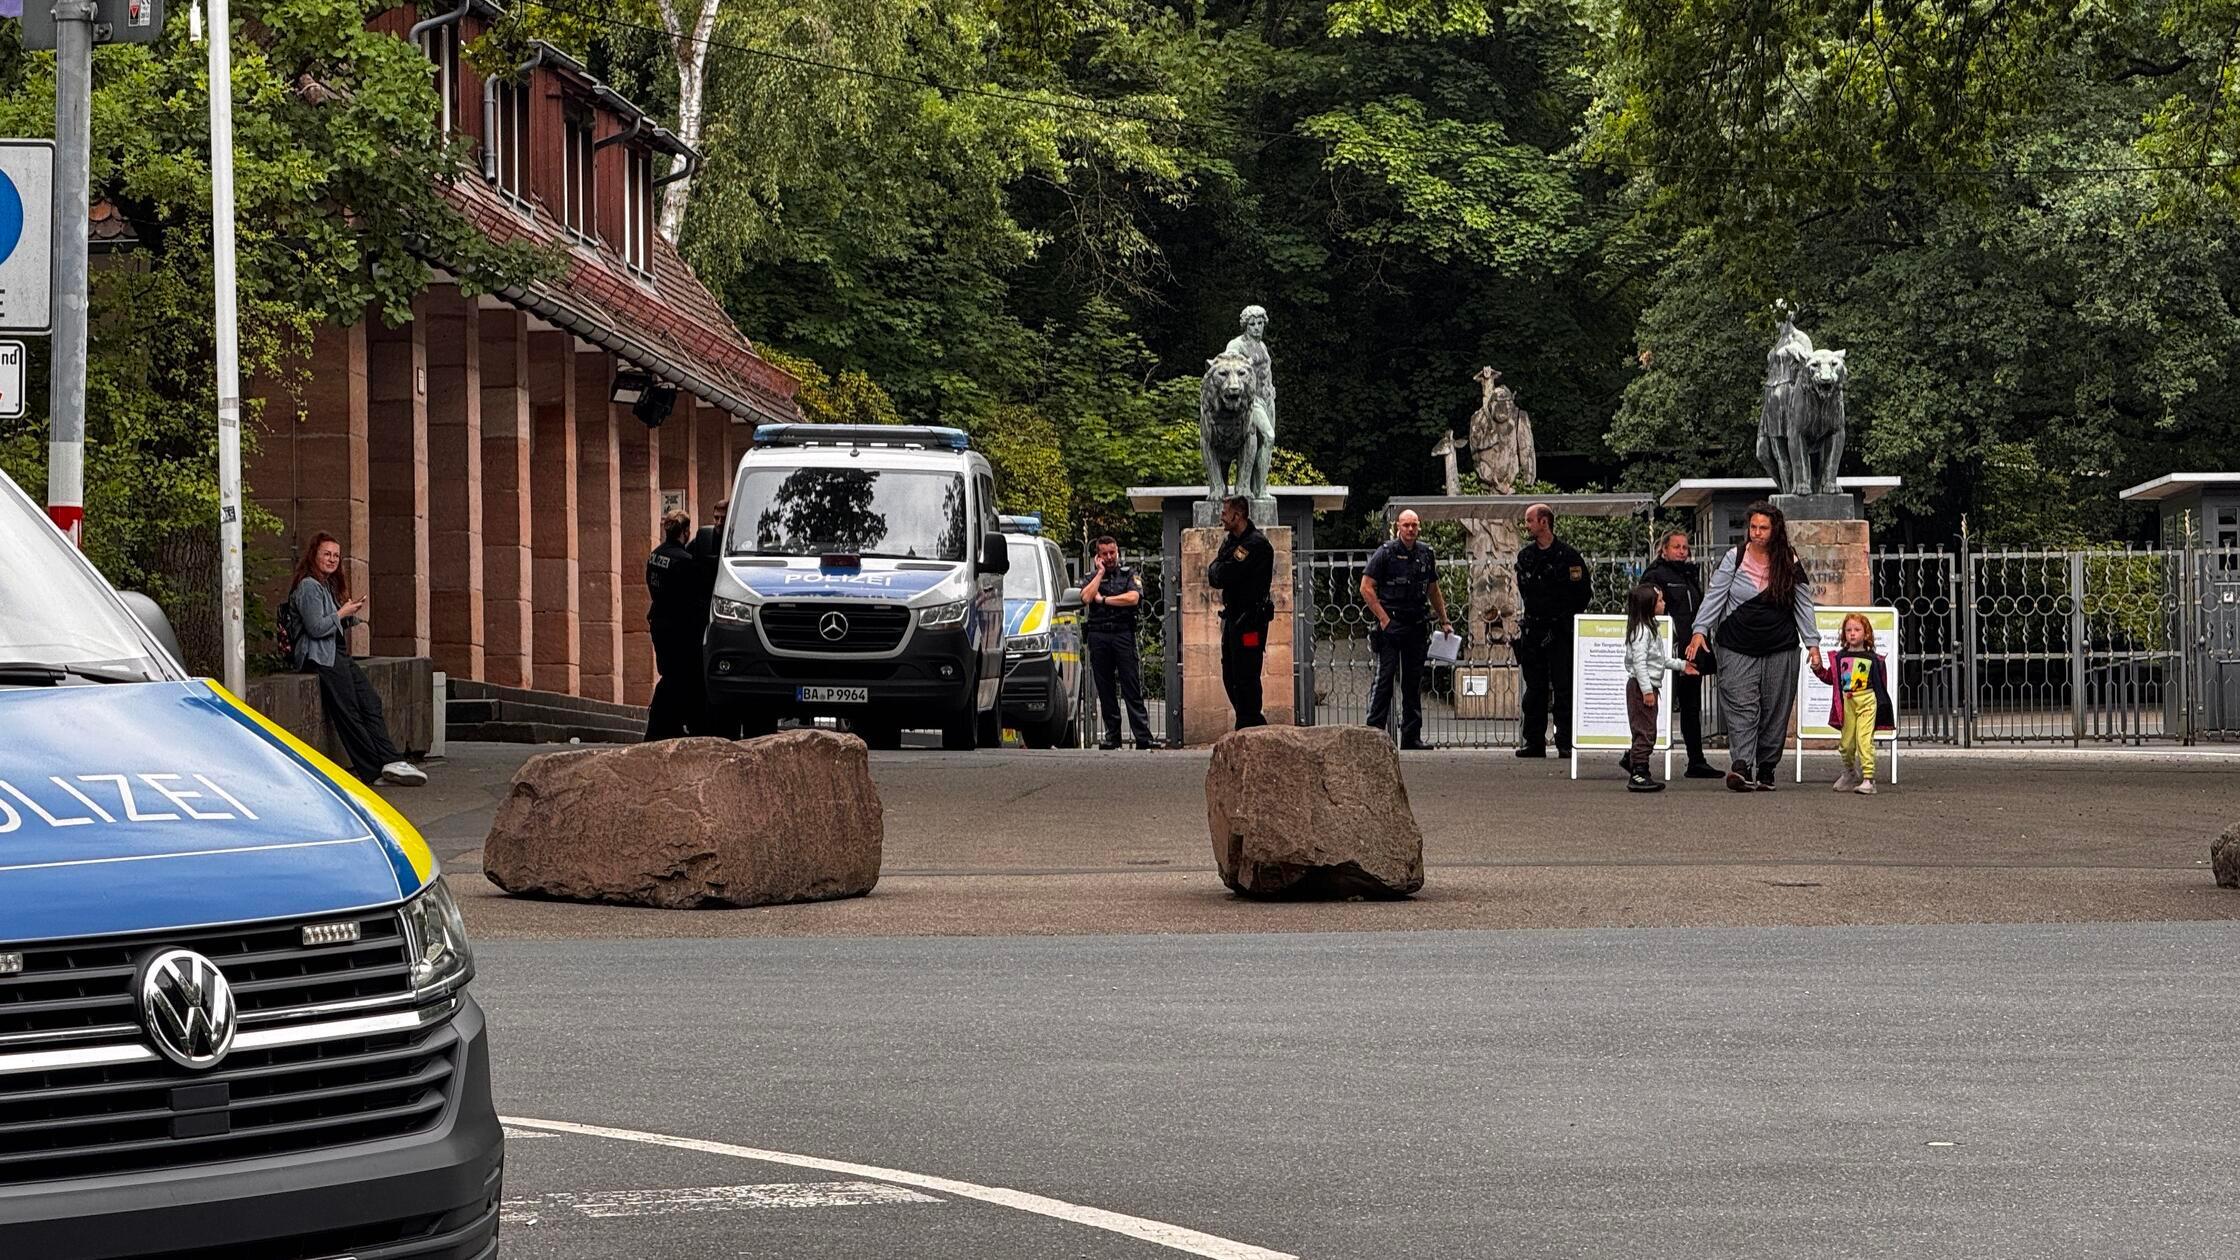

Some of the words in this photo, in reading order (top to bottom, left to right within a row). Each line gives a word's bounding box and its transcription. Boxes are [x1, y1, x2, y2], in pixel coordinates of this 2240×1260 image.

[1, 349, 18, 365] nd
[648, 552, 671, 569] OLIZEI
[784, 574, 892, 587] POLIZEI
[803, 688, 819, 700] BA
[827, 688, 834, 700] P
[836, 689, 866, 701] 9964
[0, 774, 260, 834] LIZEI
